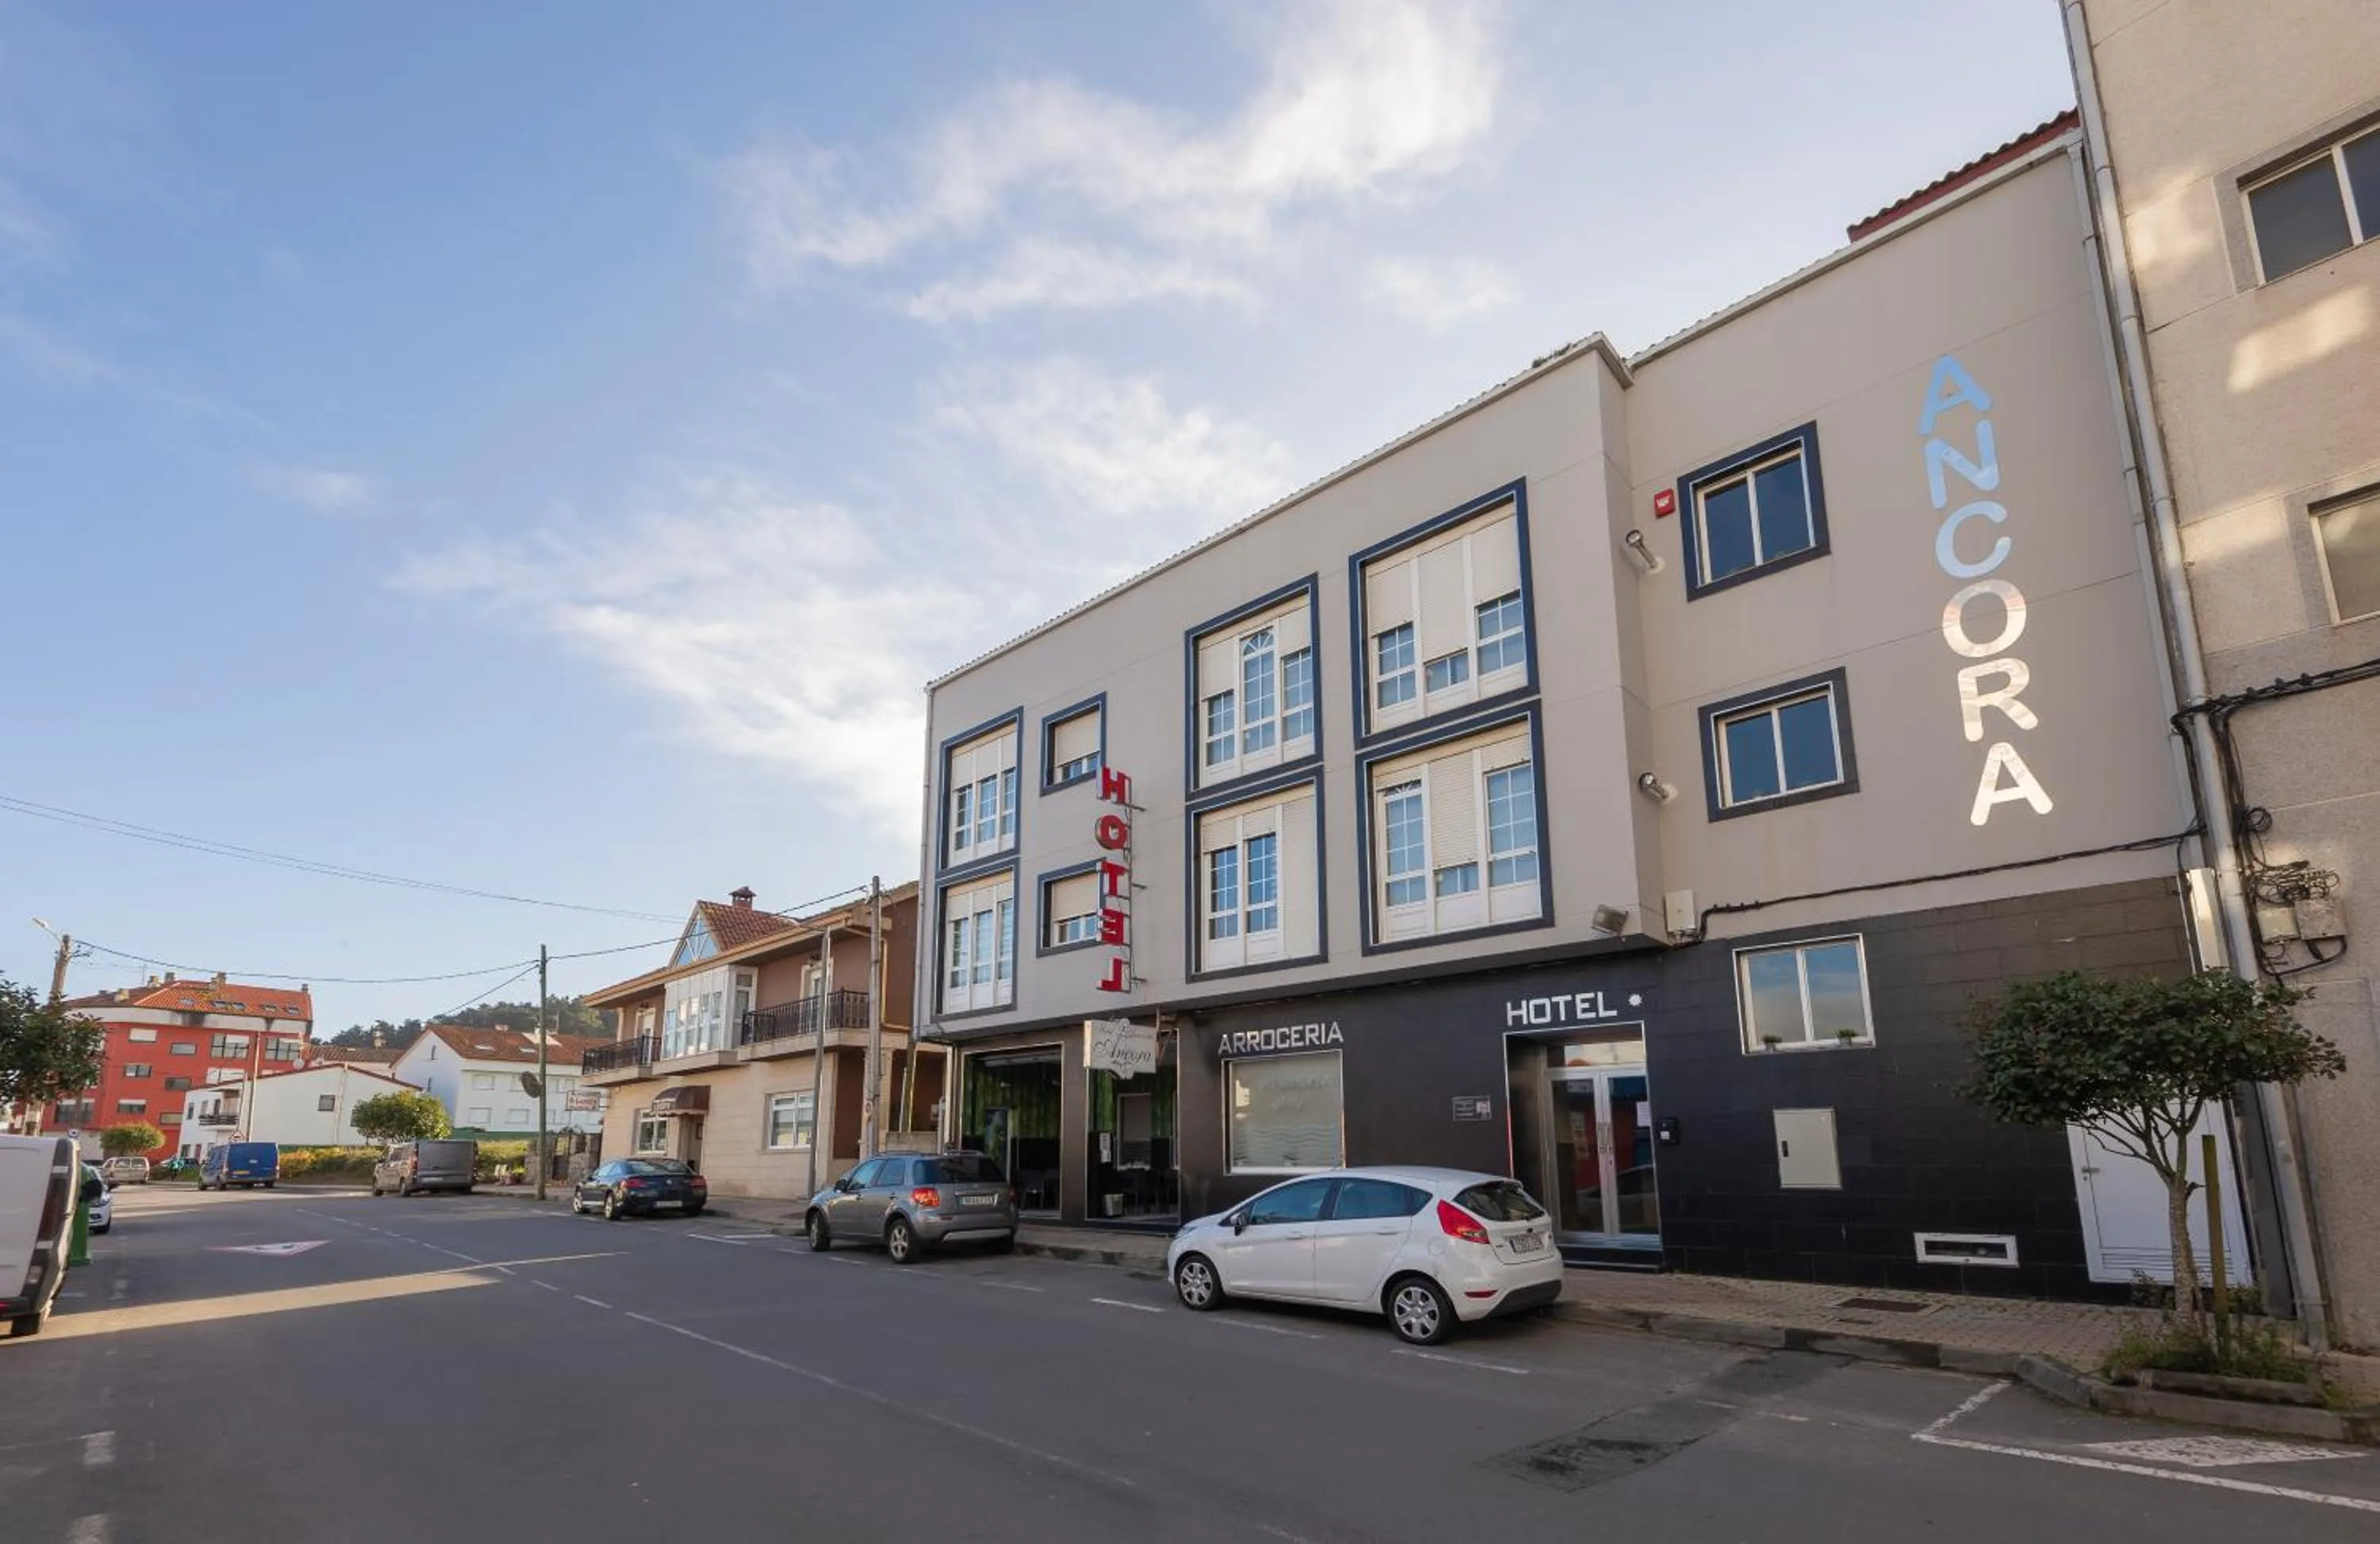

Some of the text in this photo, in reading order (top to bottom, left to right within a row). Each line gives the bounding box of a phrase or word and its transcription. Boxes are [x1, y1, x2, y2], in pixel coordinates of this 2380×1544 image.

[1917, 354, 2053, 826] ANCORA
[1507, 991, 1618, 1026] HOTEL
[1219, 1021, 1344, 1055] ARROCERIA
